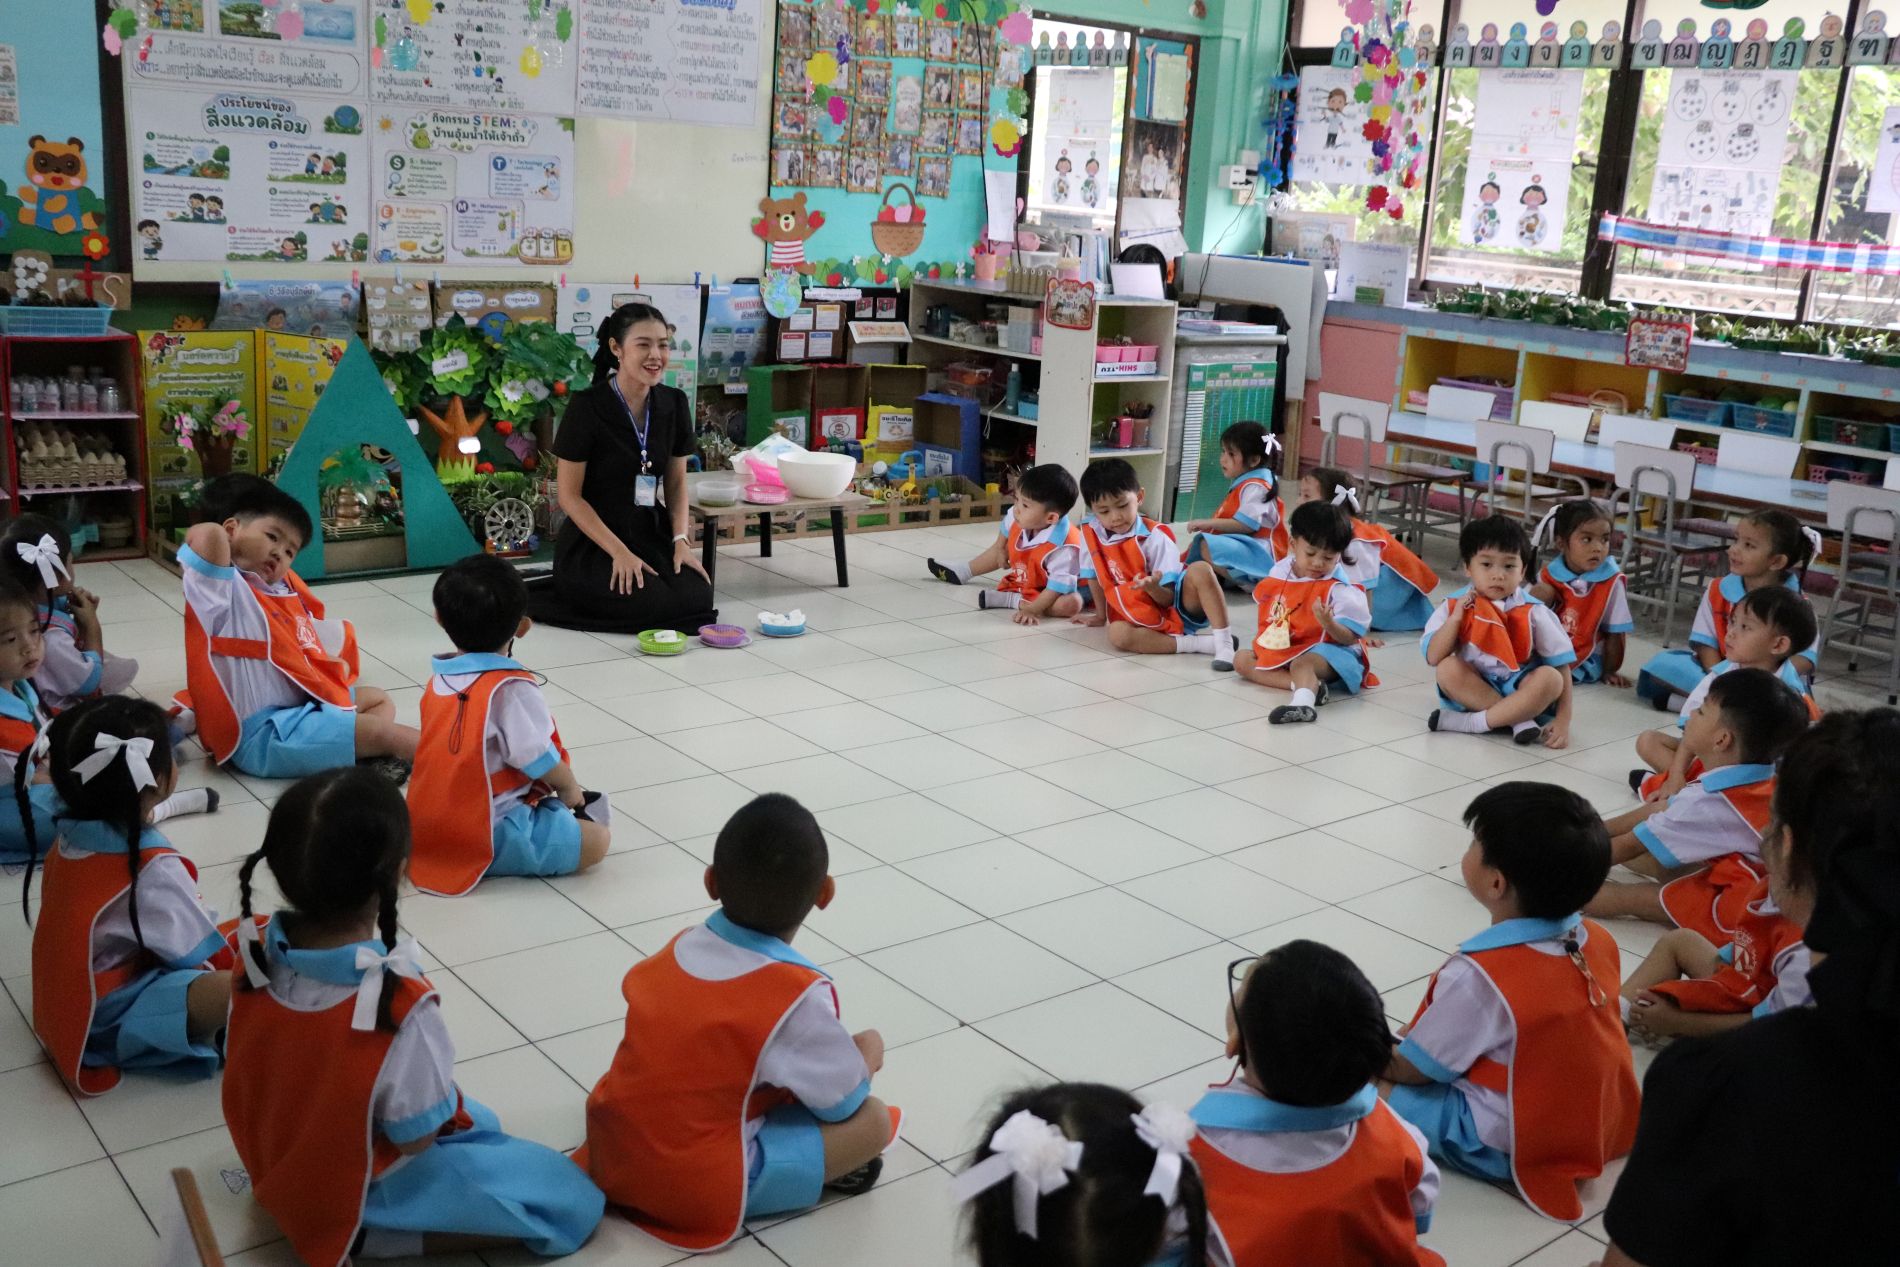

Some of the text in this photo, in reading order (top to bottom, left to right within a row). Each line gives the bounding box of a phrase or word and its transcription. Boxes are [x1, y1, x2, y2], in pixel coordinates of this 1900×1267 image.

[1340, 47, 1349, 61] ก
[1510, 46, 1519, 61] ง
[1541, 45, 1552, 61] จ
[1570, 44, 1582, 61] ฉ
[1641, 44, 1656, 61] ซ
[1673, 43, 1693, 60] ฌ
[1707, 43, 1727, 68] ญ
[1778, 41, 1797, 67] ฏ
[1816, 40, 1835, 66] ฐ
[220, 96, 292, 113] ประโยชน์ของ
[206, 105, 307, 135] สิ่งแวดล้อม
[432, 112, 517, 128] กิจกรรม STEM:
[433, 126, 525, 143] บ้านอุ้มน้ำให้เจ้าถั่ว
[393, 157, 401, 169] S
[420, 158, 443, 166] Science
[495, 159, 504, 170] T
